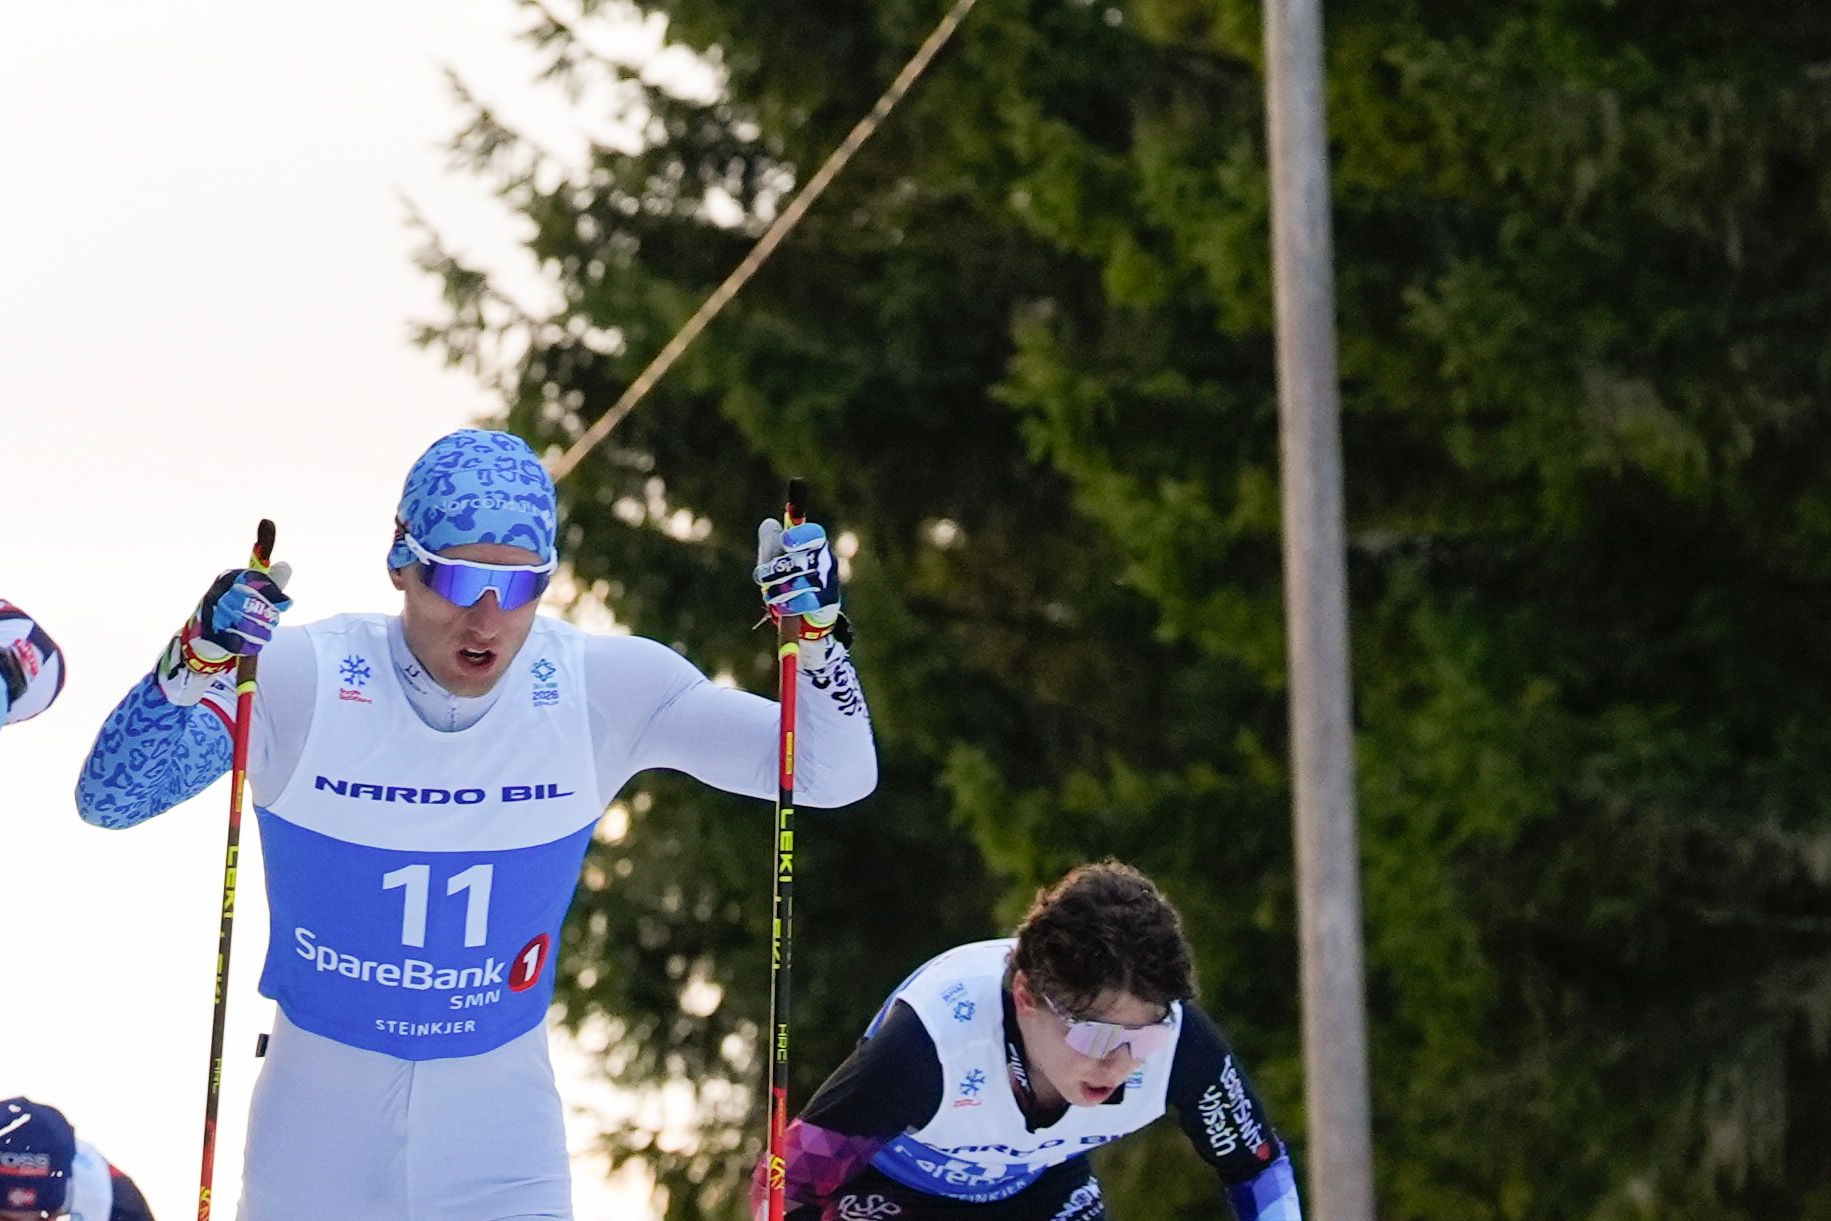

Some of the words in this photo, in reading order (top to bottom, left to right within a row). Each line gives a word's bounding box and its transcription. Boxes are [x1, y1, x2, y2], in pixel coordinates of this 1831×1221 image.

[315, 776, 486, 804] NARDO
[502, 784, 574, 802] BIL
[779, 808, 794, 882] LEKI
[382, 864, 494, 948] 11
[295, 927, 506, 990] SpareBank
[450, 989, 501, 1010] SMN
[376, 1019, 476, 1037] STEINKJER
